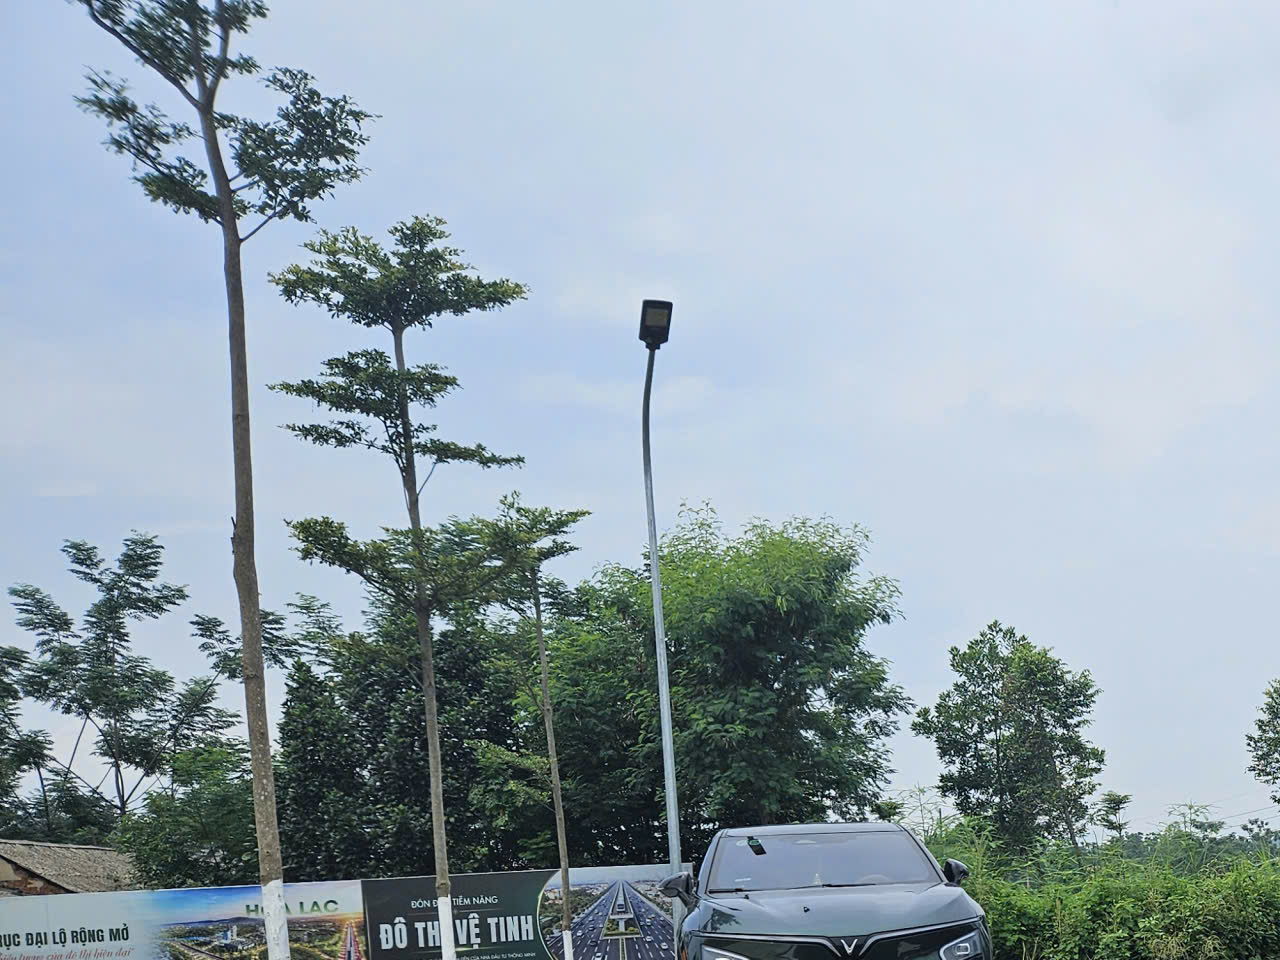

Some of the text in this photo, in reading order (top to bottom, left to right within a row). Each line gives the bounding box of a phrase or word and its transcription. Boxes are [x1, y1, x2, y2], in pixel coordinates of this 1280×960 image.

[411, 898, 430, 908] ĐÓN
[473, 895, 498, 904] NĂNG
[25, 931, 48, 948] ĐẠI
[52, 928, 67, 947] LỘ
[70, 927, 105, 946] RỘNG
[109, 923, 129, 942] MỞ
[379, 913, 534, 950] ĐÔ TH VỆ TINH
